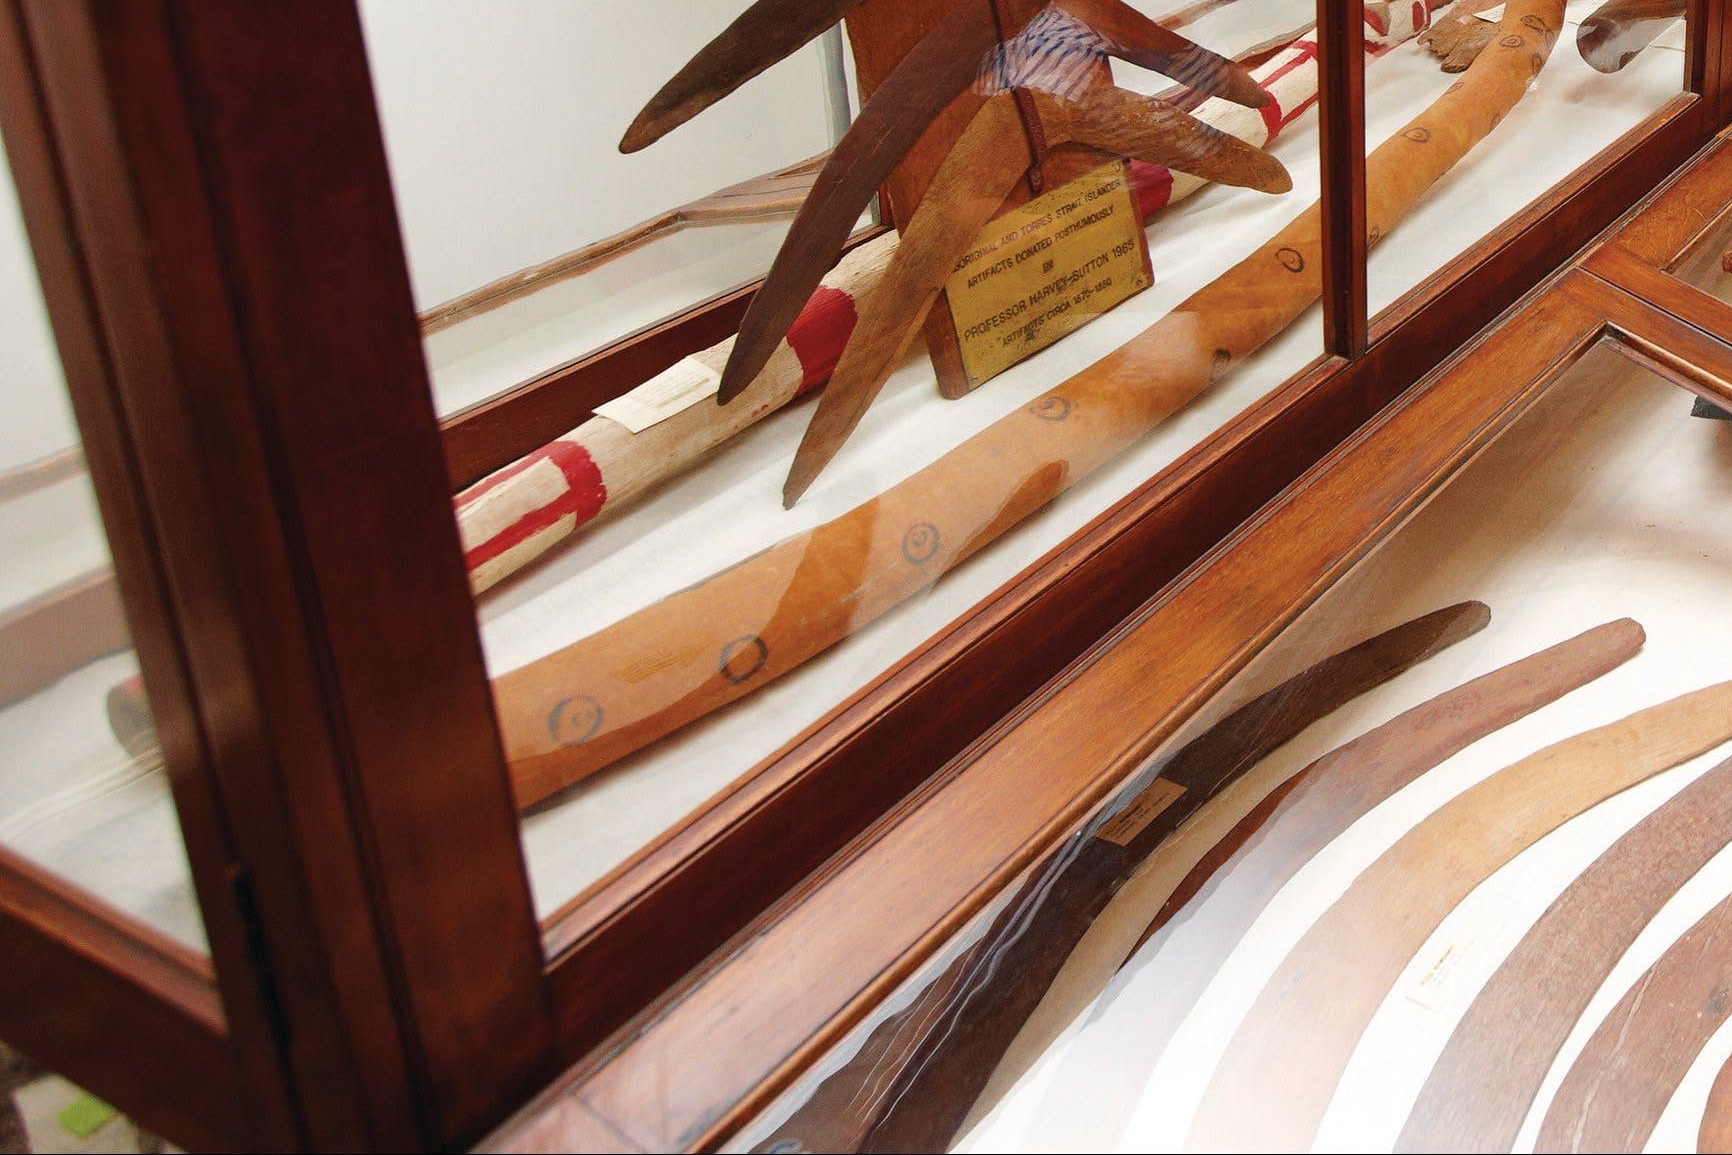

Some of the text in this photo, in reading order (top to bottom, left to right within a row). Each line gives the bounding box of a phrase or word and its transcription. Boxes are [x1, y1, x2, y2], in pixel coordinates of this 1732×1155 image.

[951, 179, 1121, 274] BORIGINAL AND TORRES STRAIT ISLANDER
[967, 204, 1114, 290] ARTIFACTS DONATED POSTHUMOUSLY
[964, 299, 1027, 342] PROFESSOR
[1029, 253, 1109, 306] HARVEY-SUTTON
[1046, 301, 1072, 320] CIRCA
